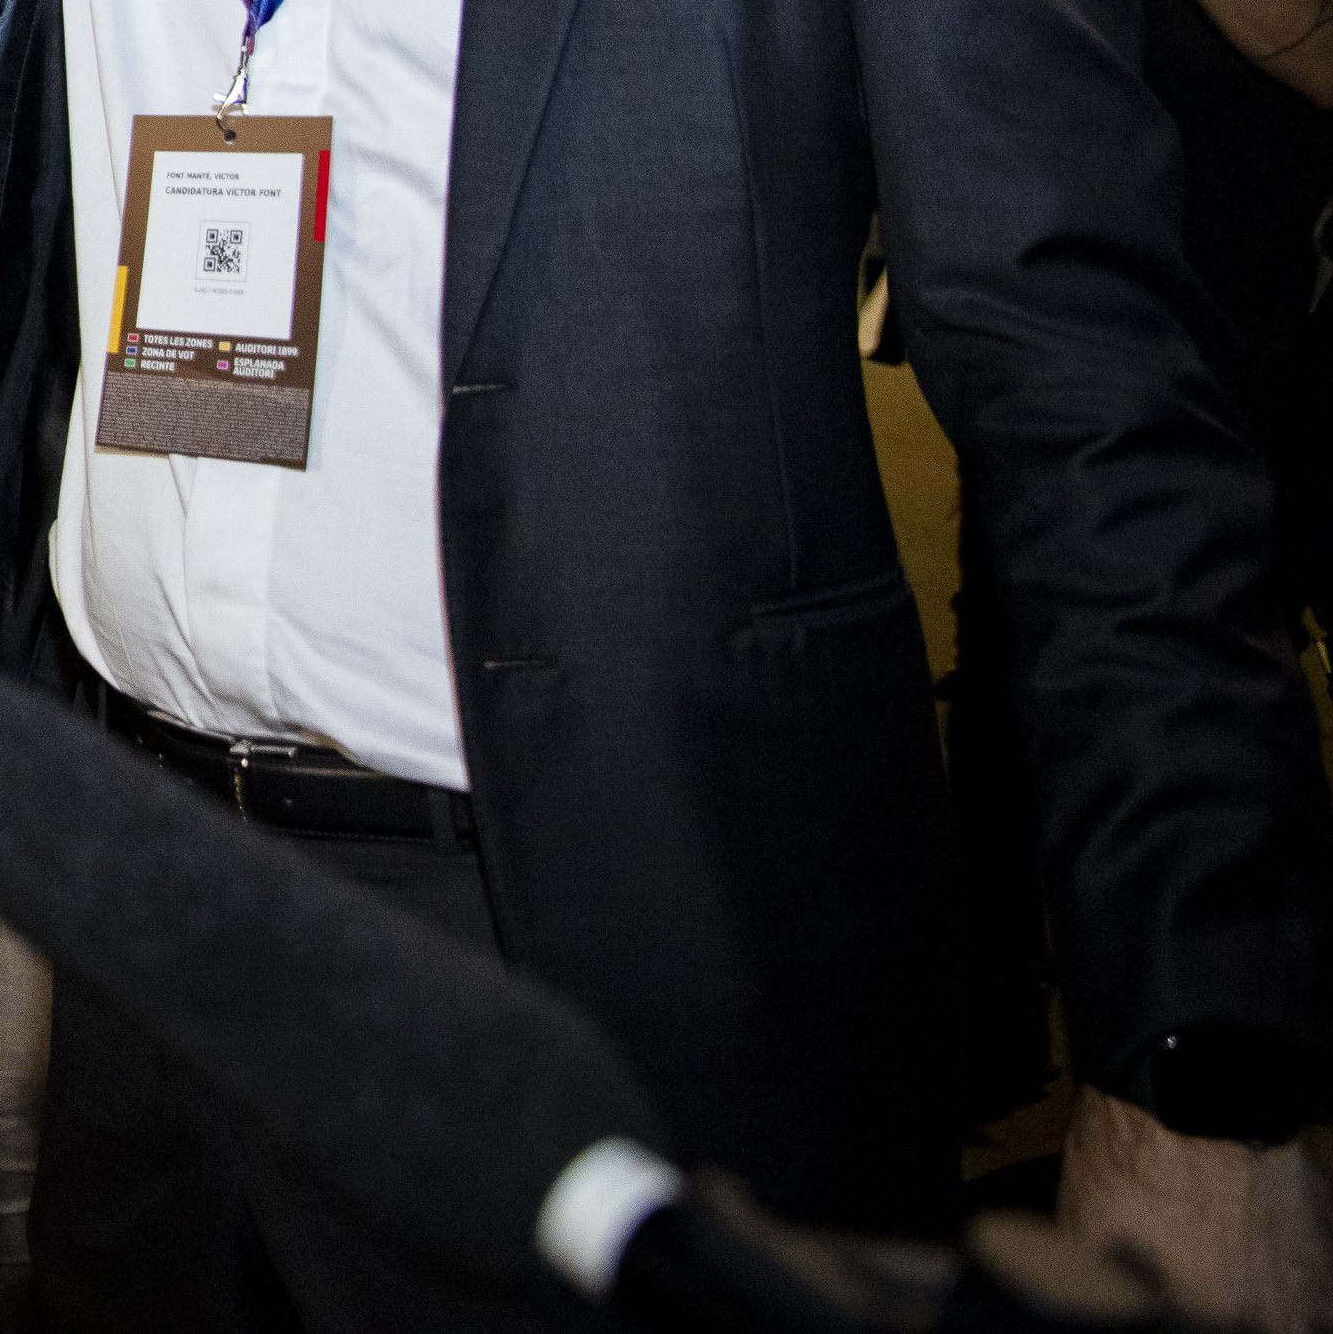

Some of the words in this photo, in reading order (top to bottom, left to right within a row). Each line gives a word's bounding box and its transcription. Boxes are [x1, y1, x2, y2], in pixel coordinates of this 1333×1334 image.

[166, 171, 185, 179] FONT
[165, 186, 224, 197] CANDIDATURA
[226, 186, 256, 197] VÍCTOR
[258, 188, 282, 198] FONT
[143, 334, 168, 345] TOTES
[169, 336, 184, 346] LES
[185, 337, 213, 349] ZONES
[141, 347, 165, 358] ZONA
[166, 348, 177, 358] DE
[178, 350, 195, 360] VOT
[235, 343, 277, 355] AUDITORI
[277, 346, 299, 357] 1899
[140, 360, 175, 372] RECINTE
[233, 357, 285, 370] ESPLANADA
[232, 368, 275, 379] AUDITORI
